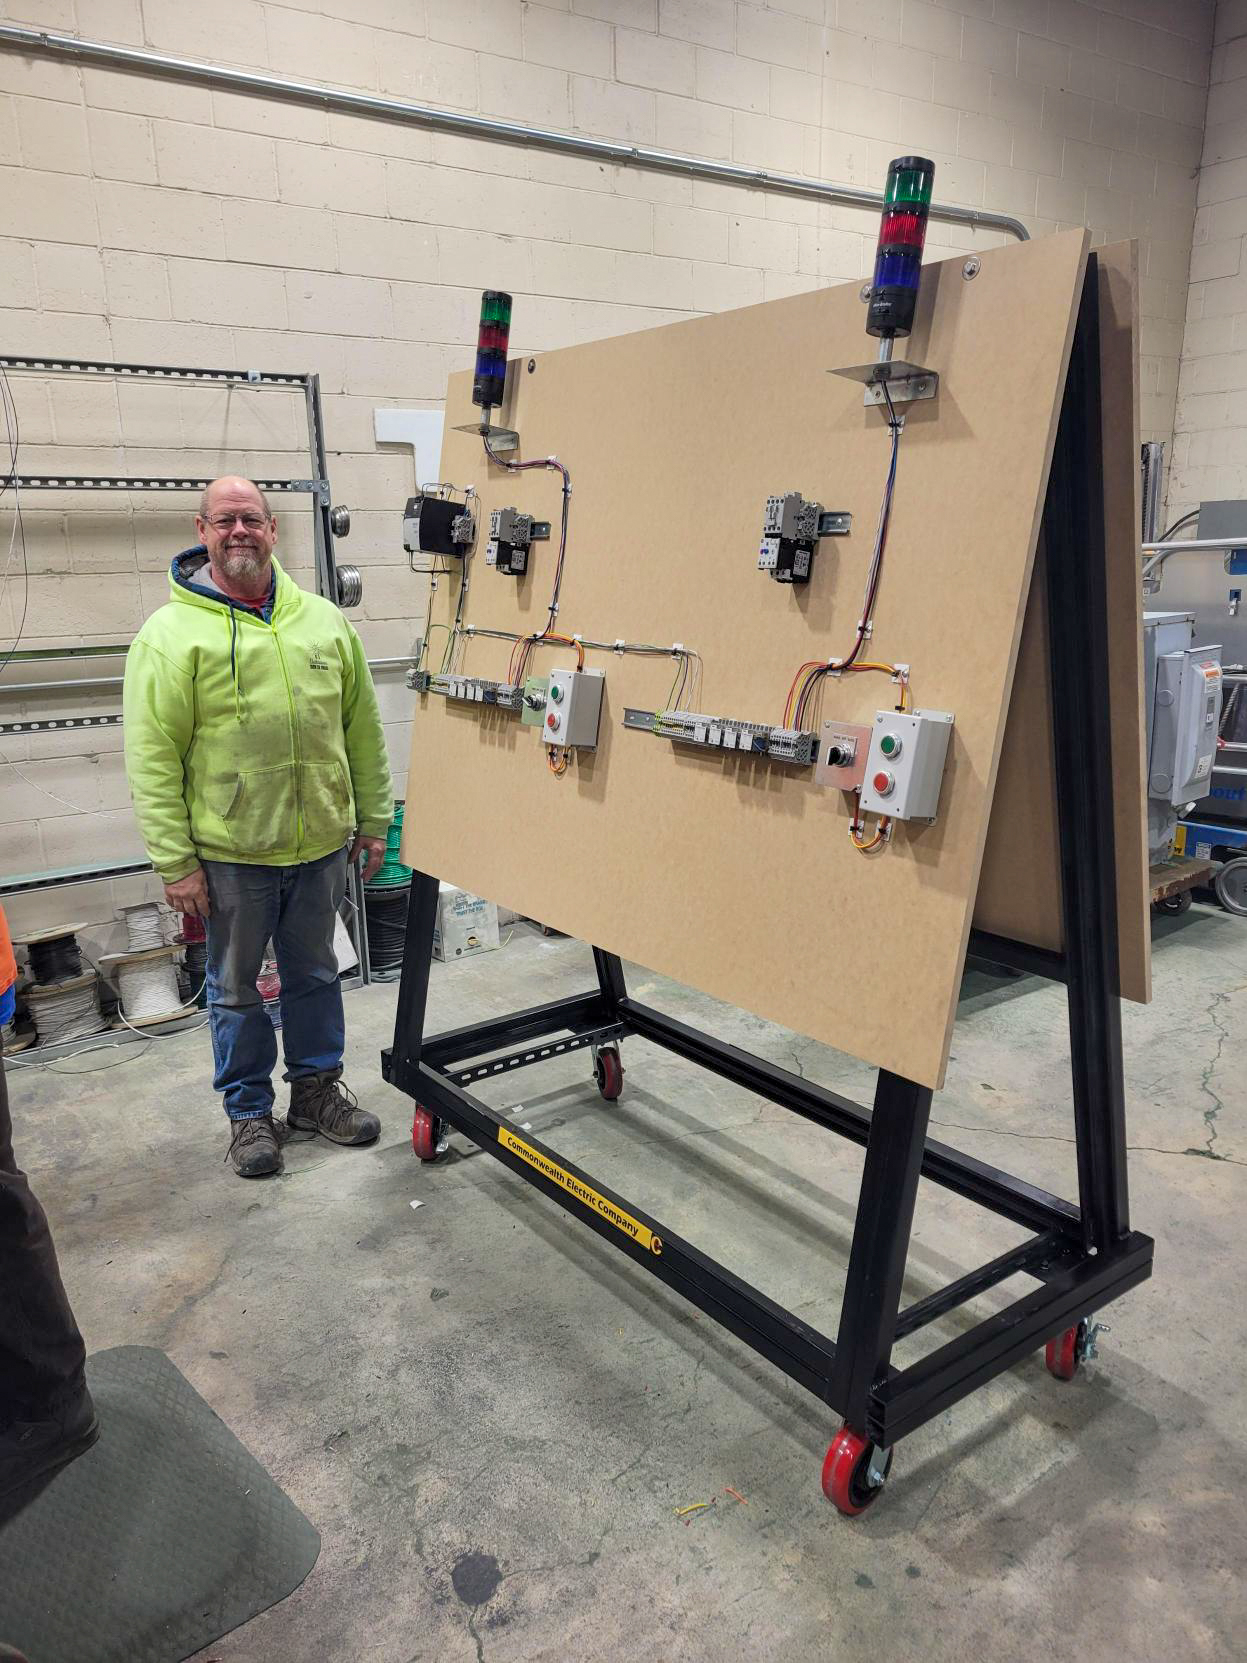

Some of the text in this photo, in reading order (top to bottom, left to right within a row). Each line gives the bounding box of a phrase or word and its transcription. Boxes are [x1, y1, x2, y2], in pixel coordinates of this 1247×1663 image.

[507, 1137, 639, 1237] Commonwealth Electric Company
